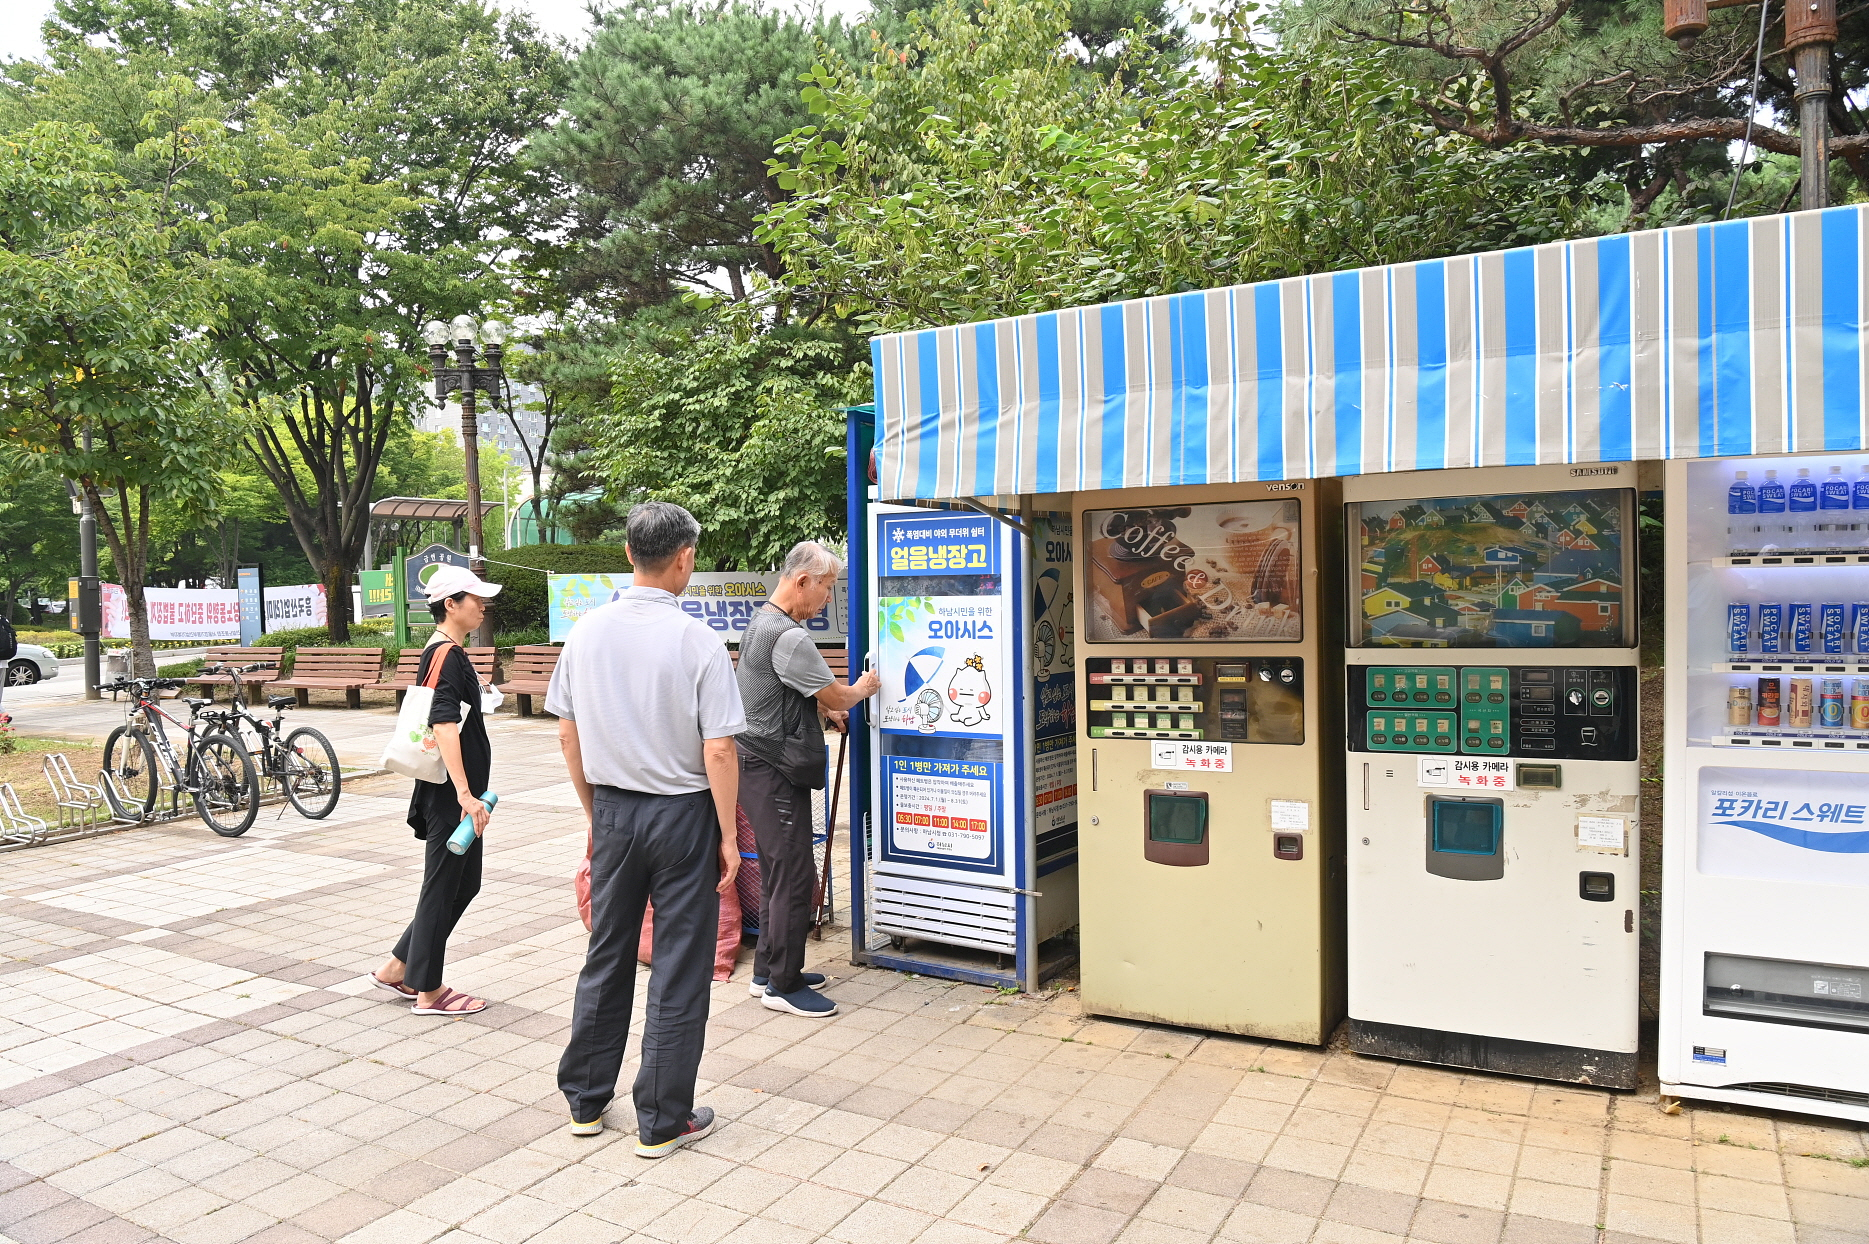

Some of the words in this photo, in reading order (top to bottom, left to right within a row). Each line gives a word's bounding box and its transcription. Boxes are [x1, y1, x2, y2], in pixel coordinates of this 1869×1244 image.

[1266, 482, 1304, 491] venson
[906, 530, 932, 540] 폭염대비
[934, 529, 947, 538] 야외
[949, 528, 969, 538] 무더위
[1101, 512, 1194, 571] Coffee
[891, 544, 987, 570] 얼음냉장고
[707, 585, 723, 596] 위한
[724, 582, 767, 597] 오아시스
[938, 607, 975, 616] 하남시민을
[977, 607, 992, 616] 위한
[1199, 580, 1296, 637] Drink
[928, 620, 993, 639] 오아시스
[902, 714, 916, 726] 하남
[1182, 745, 1203, 754] 감시용
[1206, 745, 1227, 755] 카메라
[894, 760, 907, 771] 1인
[910, 761, 932, 772] 1병만
[934, 763, 959, 774] 가져가
[961, 765, 988, 776] 주세요
[1185, 758, 1196, 767] 녹
[1200, 758, 1211, 768] 화
[1214, 759, 1225, 768] 중
[1455, 761, 1479, 771] 감시용
[1483, 762, 1509, 772] 카메라
[1458, 775, 1471, 785] 녹
[1476, 776, 1488, 786] 화
[1493, 776, 1505, 787] 중
[1712, 798, 1789, 820] 포카리
[1790, 802, 1866, 824] 스웨트
[915, 816, 929, 824] 07:00
[934, 818, 948, 826] 11:00
[952, 820, 966, 828] 14:00
[971, 821, 985, 830] 17:00
